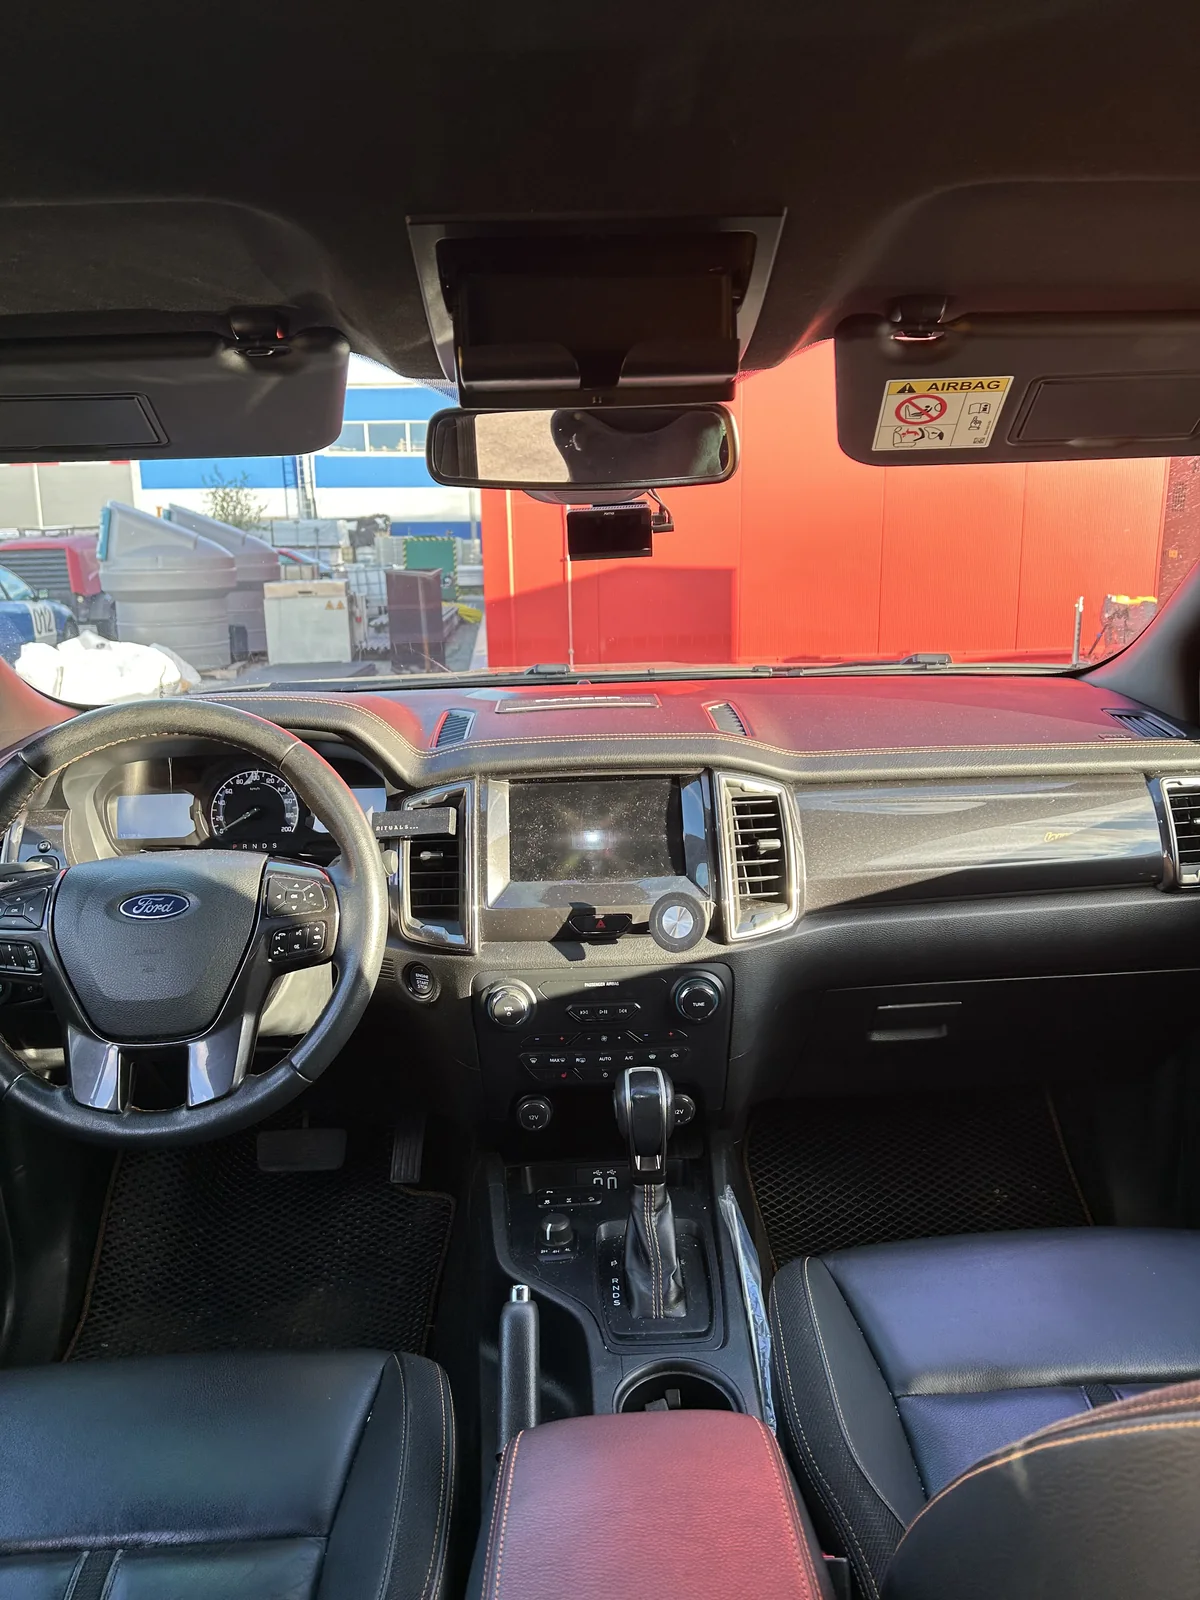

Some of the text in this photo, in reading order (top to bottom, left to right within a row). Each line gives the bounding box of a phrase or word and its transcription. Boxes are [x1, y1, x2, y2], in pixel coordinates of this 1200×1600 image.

[926, 380, 1001, 392] AIRBAG
[33, 605, 54, 635] 012
[132, 897, 175, 914] Ford
